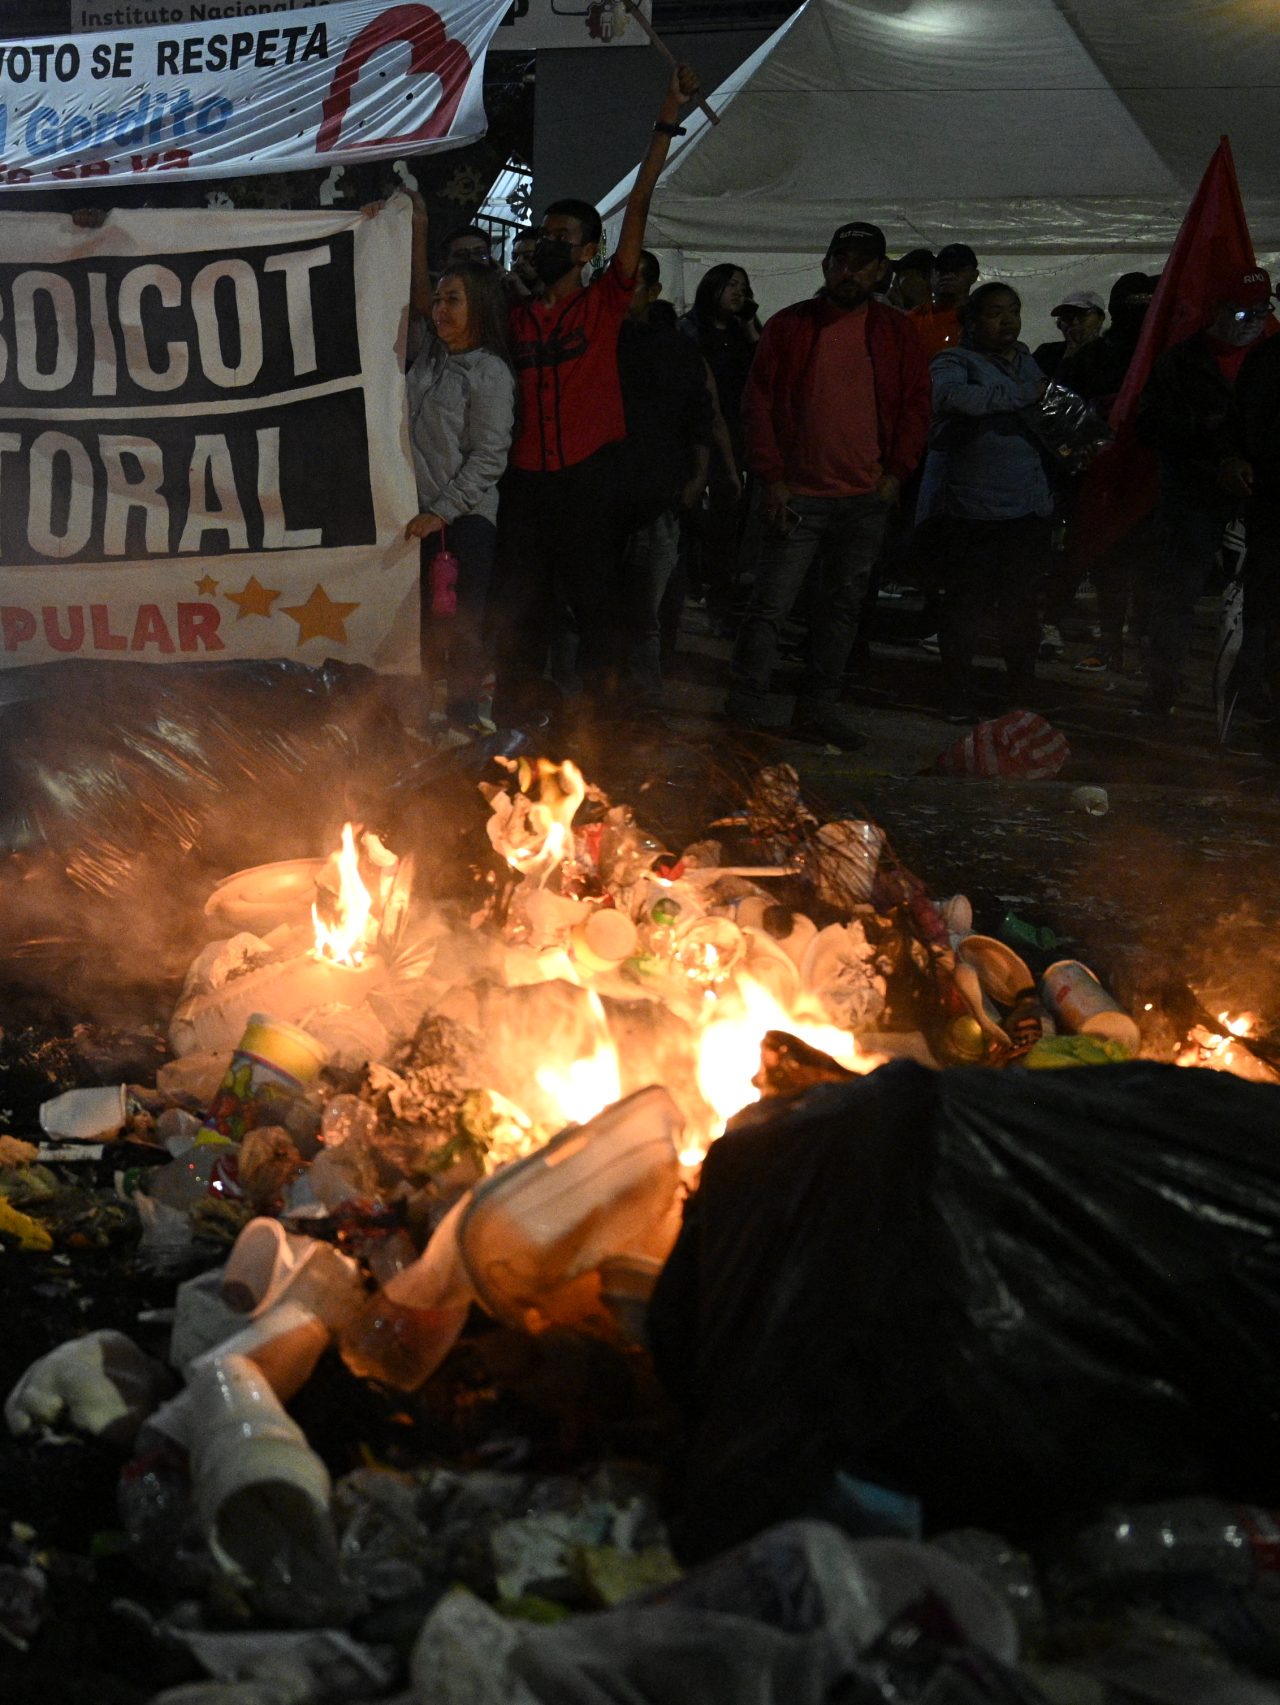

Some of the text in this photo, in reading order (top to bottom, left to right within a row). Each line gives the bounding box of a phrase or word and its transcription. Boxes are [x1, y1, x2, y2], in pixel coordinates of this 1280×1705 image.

[81, 6, 183, 26] Instituto
[190, 0, 294, 21] Nacional
[91, 42, 134, 79] SE
[157, 22, 329, 76] RESPETA
[25, 89, 234, 156] Gordito
